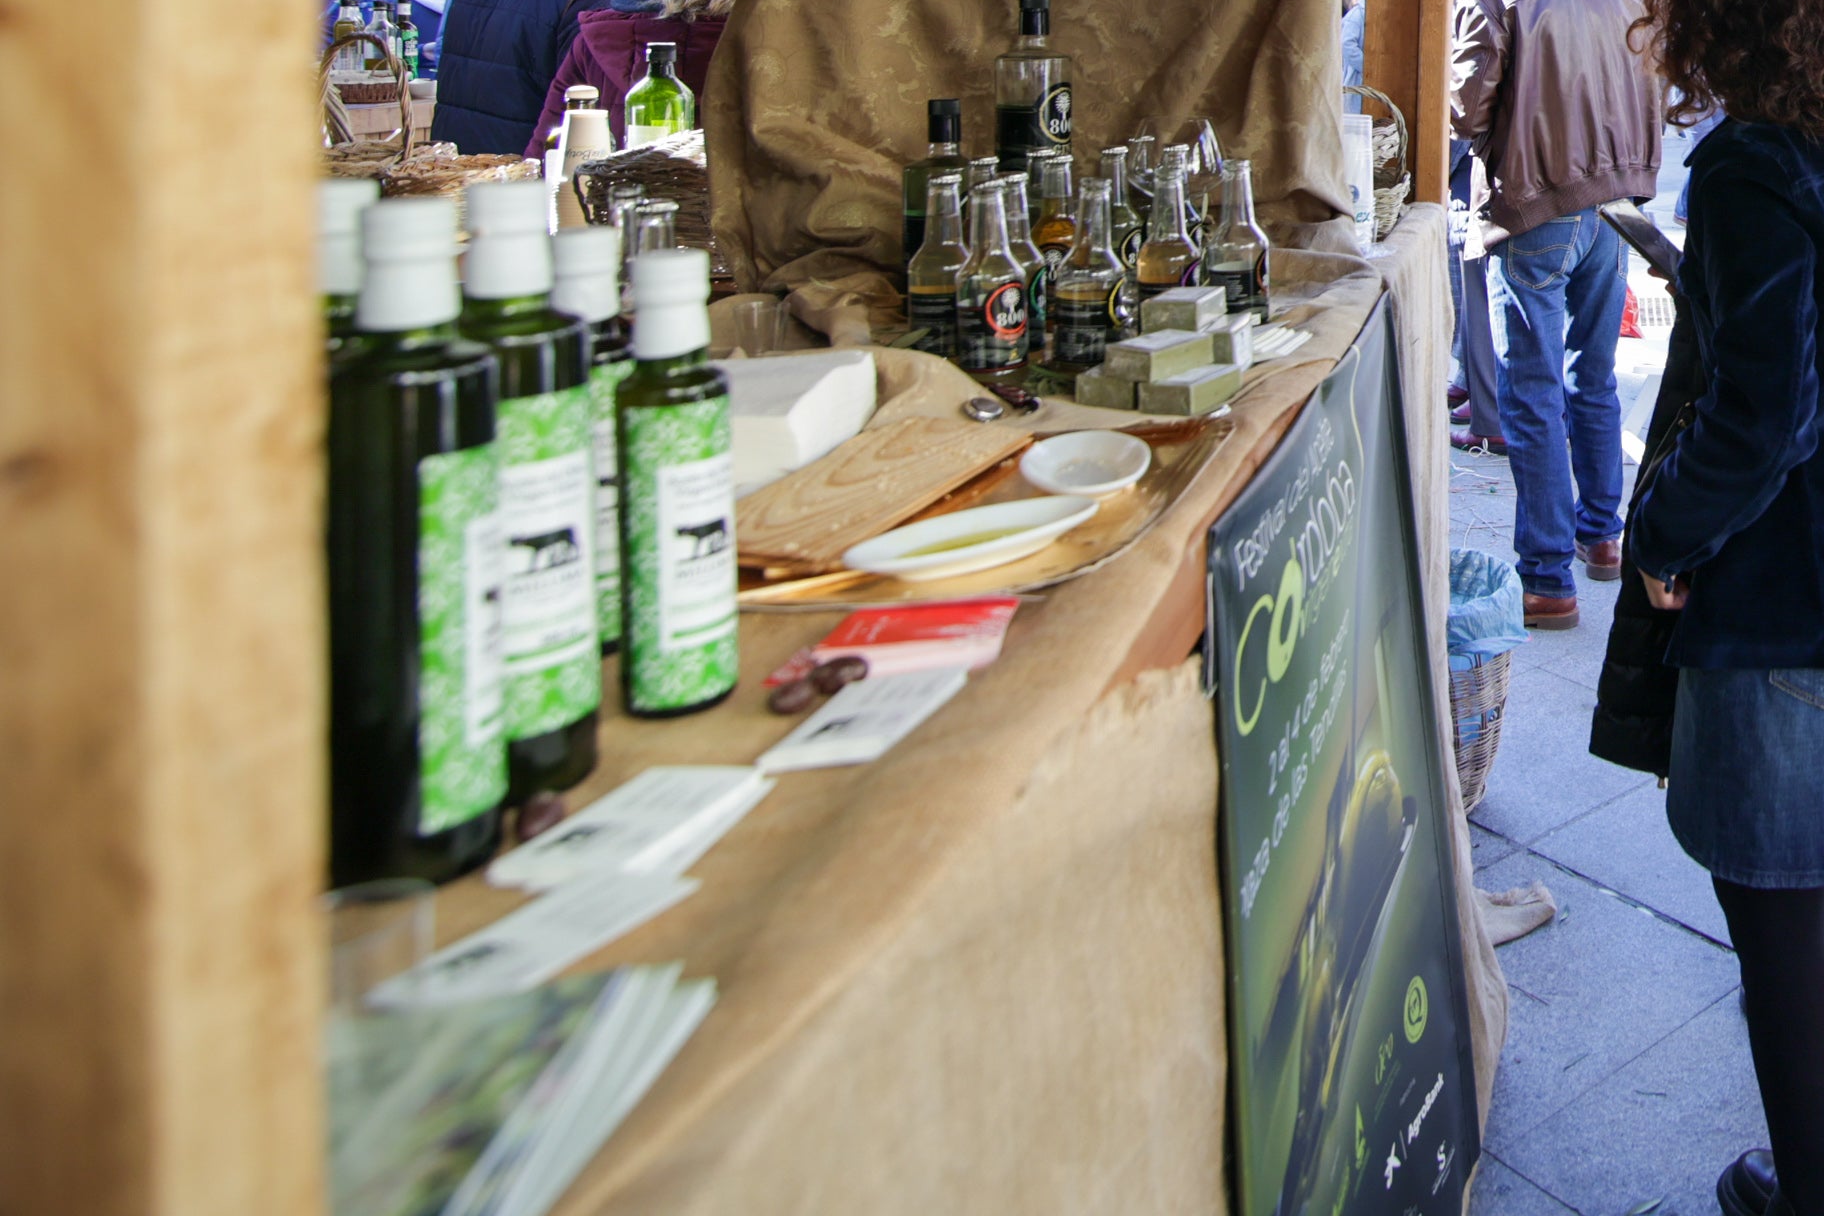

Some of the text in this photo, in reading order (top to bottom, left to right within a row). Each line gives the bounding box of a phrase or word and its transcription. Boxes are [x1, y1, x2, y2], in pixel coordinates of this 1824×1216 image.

[996, 309, 1026, 328] 800
[1233, 482, 1290, 592] Festival
[1267, 749, 1278, 796] 2
[1277, 721, 1291, 776] al
[1291, 703, 1301, 741] 4
[1301, 678, 1319, 727] de
[1271, 792, 1291, 850] de
[1407, 1071, 1445, 1145] AgroBank
